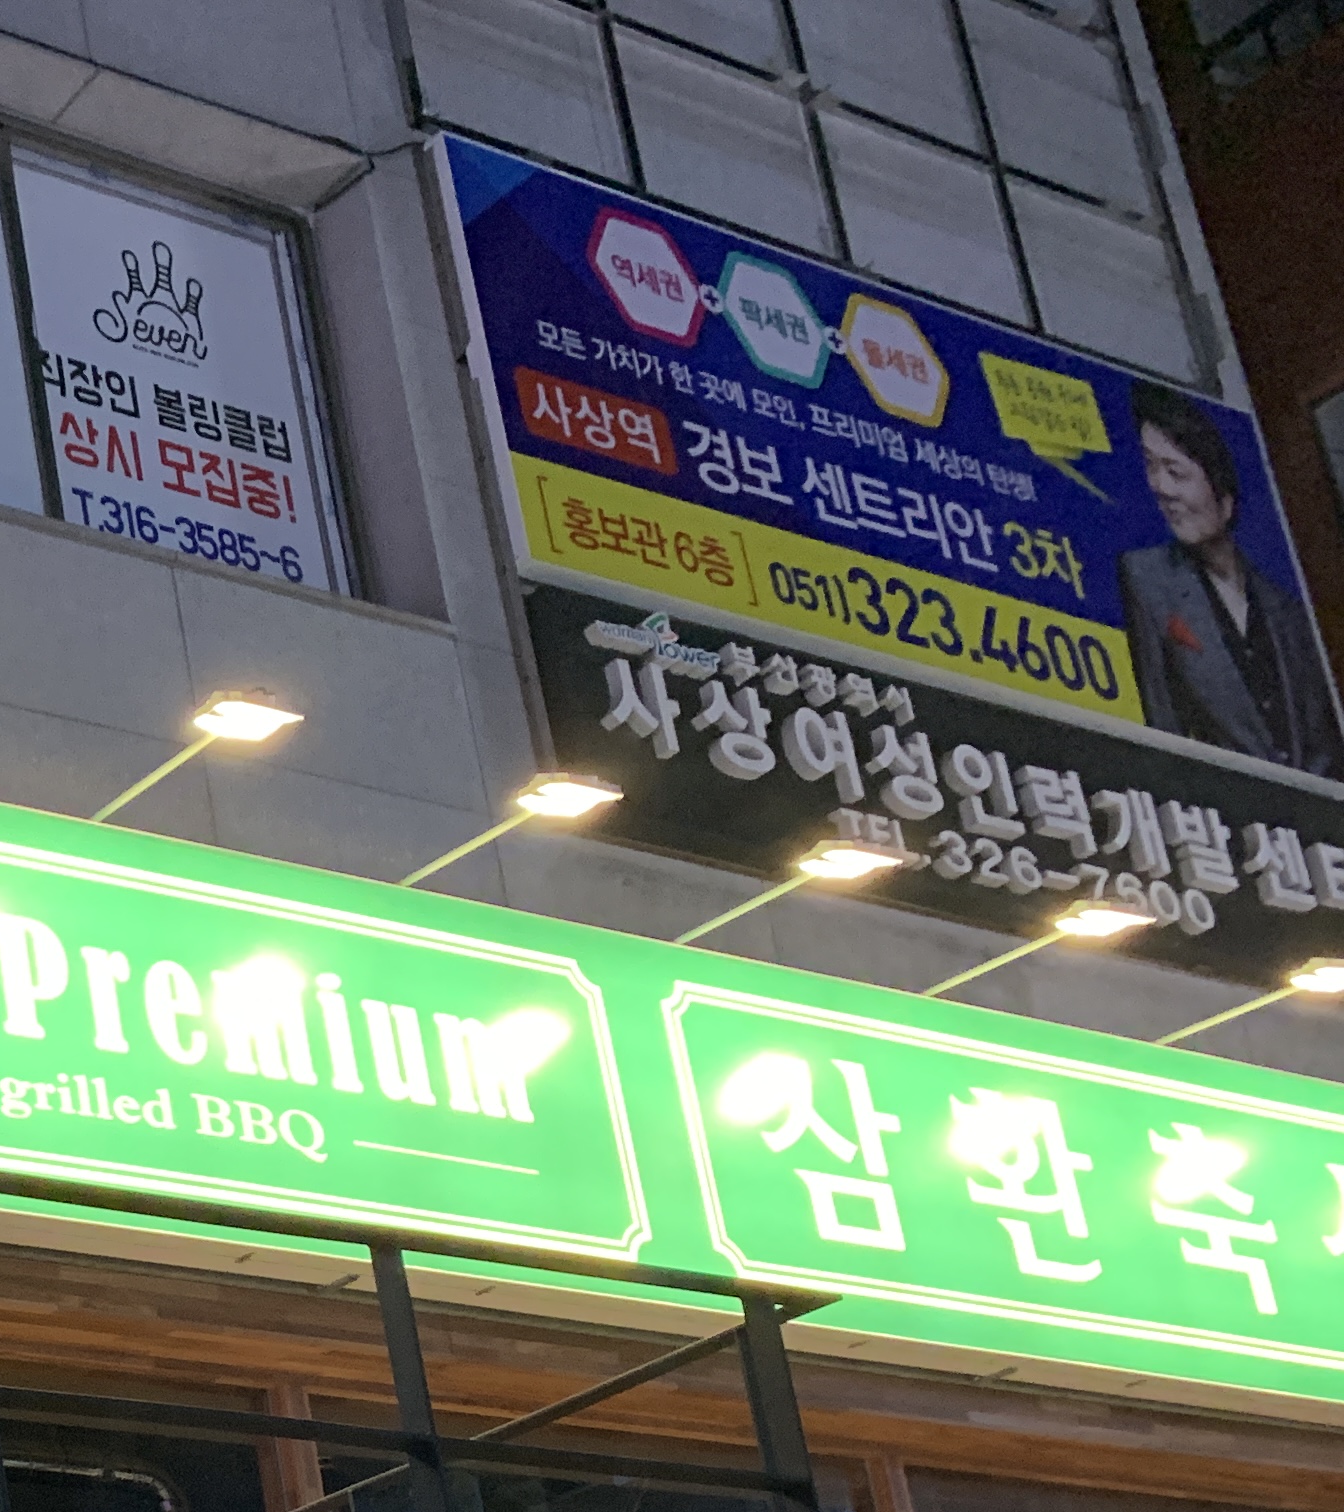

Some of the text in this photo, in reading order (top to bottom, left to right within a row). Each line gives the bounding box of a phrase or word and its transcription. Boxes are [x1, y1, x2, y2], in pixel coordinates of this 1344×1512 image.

[153, 384, 293, 464] 볼링클럽
[536, 319, 586, 360] 모든
[591, 337, 663, 385] 가치가
[669, 361, 694, 394] 한
[699, 371, 747, 411] 곳에
[808, 404, 909, 463] 프리미엄
[60, 412, 298, 524] 상시 모집중!
[532, 382, 1085, 599] 사상역 경보 센트리안 3차
[720, 642, 915, 727] 부산광역시
[0, 1073, 328, 1164] grilled BBQ
